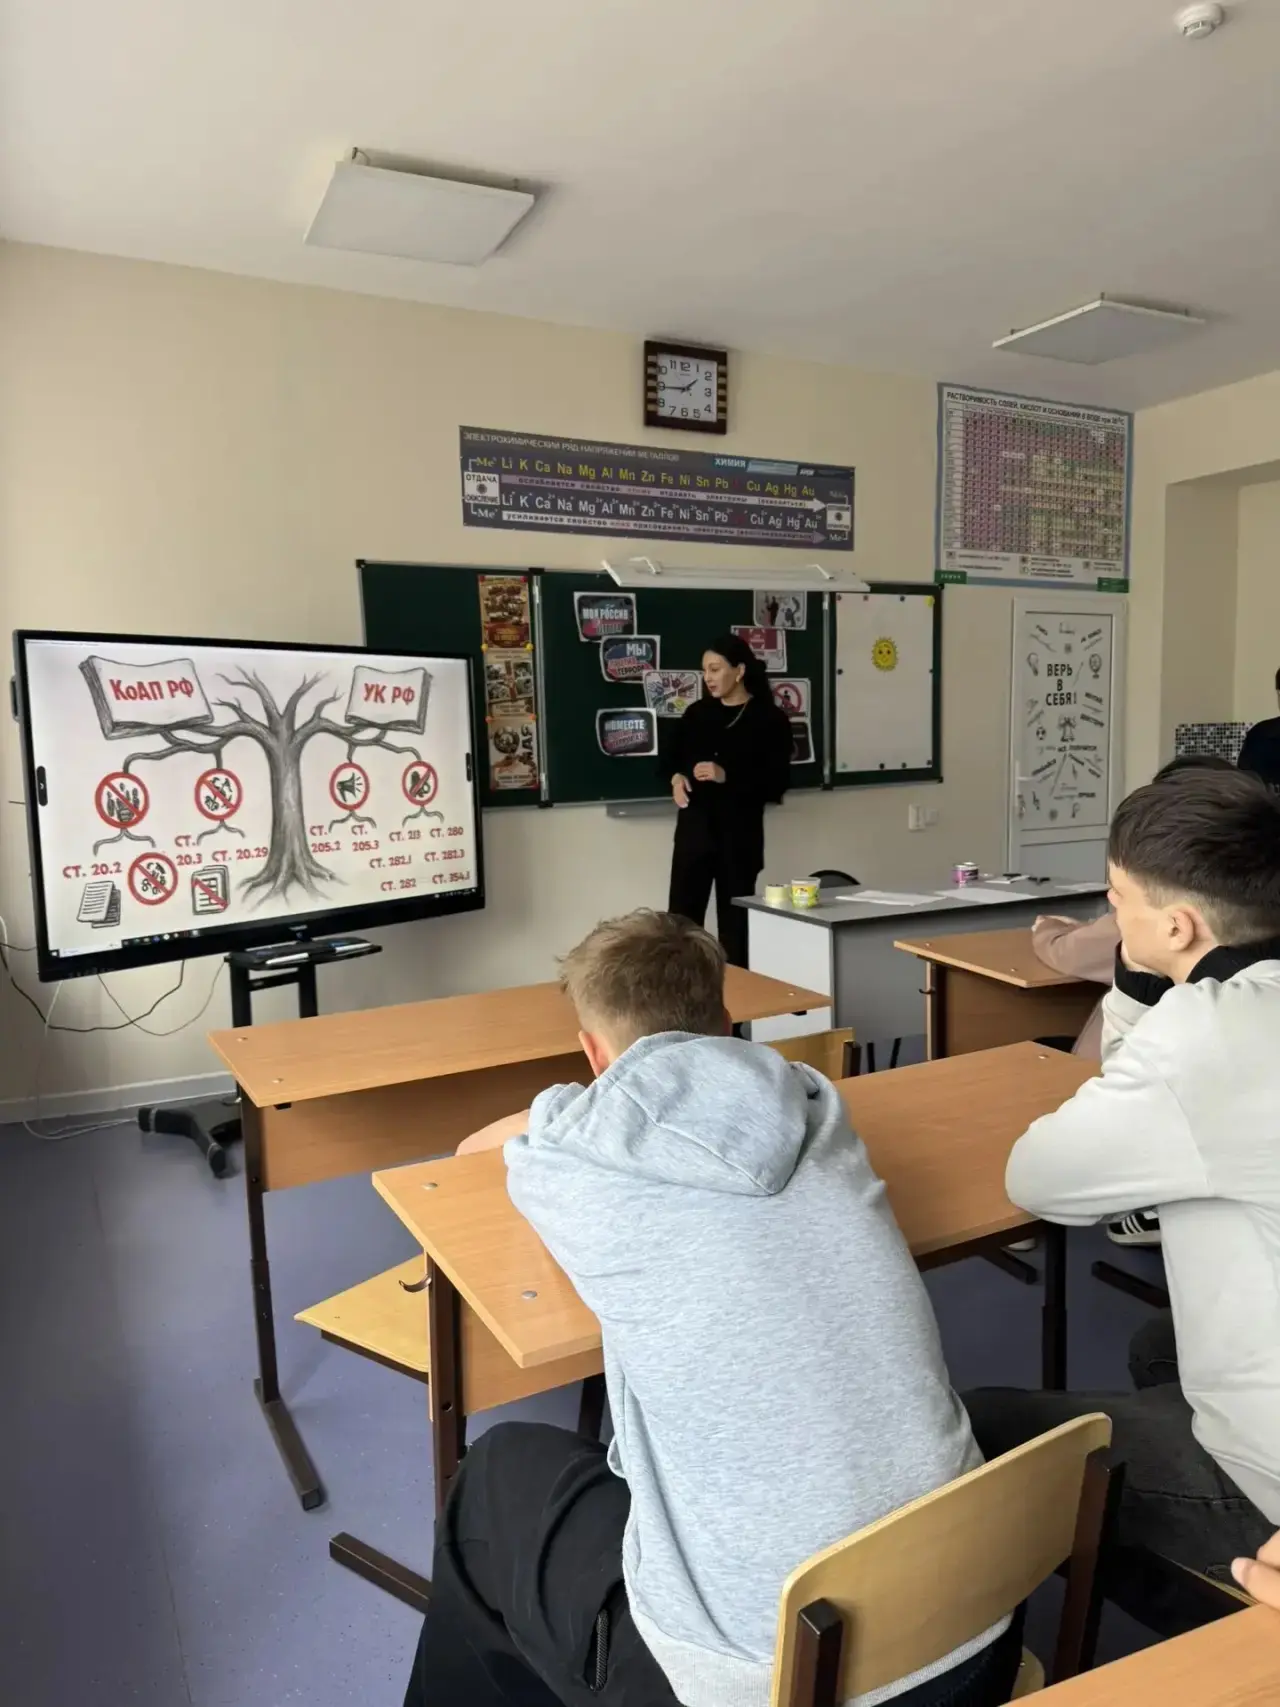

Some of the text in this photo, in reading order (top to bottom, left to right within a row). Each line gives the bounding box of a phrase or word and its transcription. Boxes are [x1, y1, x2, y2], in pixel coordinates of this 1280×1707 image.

[704, 370, 713, 382] 2
[704, 387, 712, 398] 3
[668, 405, 677, 416] 7
[704, 404, 712, 414] 4
[714, 457, 746, 468] ХИМИЯ
[465, 474, 498, 483] ОТДАЧА
[519, 458, 529, 471] K
[535, 460, 551, 473] Ca
[557, 462, 573, 475] Na
[579, 464, 596, 480] Mg
[601, 466, 614, 479] Al
[619, 467, 636, 481] Mn
[641, 470, 656, 483] Zn
[660, 472, 674, 485] Fe
[679, 473, 691, 486] Ni
[696, 475, 710, 488] Sn
[715, 477, 729, 489] Pb
[746, 480, 761, 492] Cu
[765, 481, 779, 496] Ag
[784, 483, 798, 498] Hg
[801, 485, 816, 497] Au
[626, 643, 647, 656] МЫ
[1046, 663, 1073, 677] ВЕРЬ
[110, 678, 195, 702] КоАП РФ
[1056, 678, 1064, 692] В
[364, 682, 416, 705] УК РФ
[1045, 692, 1077, 706] СЕБЯ!
[311, 840, 342, 853] 205.2
[352, 839, 380, 852] 205.3
[176, 853, 204, 866] 20.3
[236, 846, 269, 860] 20.29
[91, 861, 123, 876] 20.2
